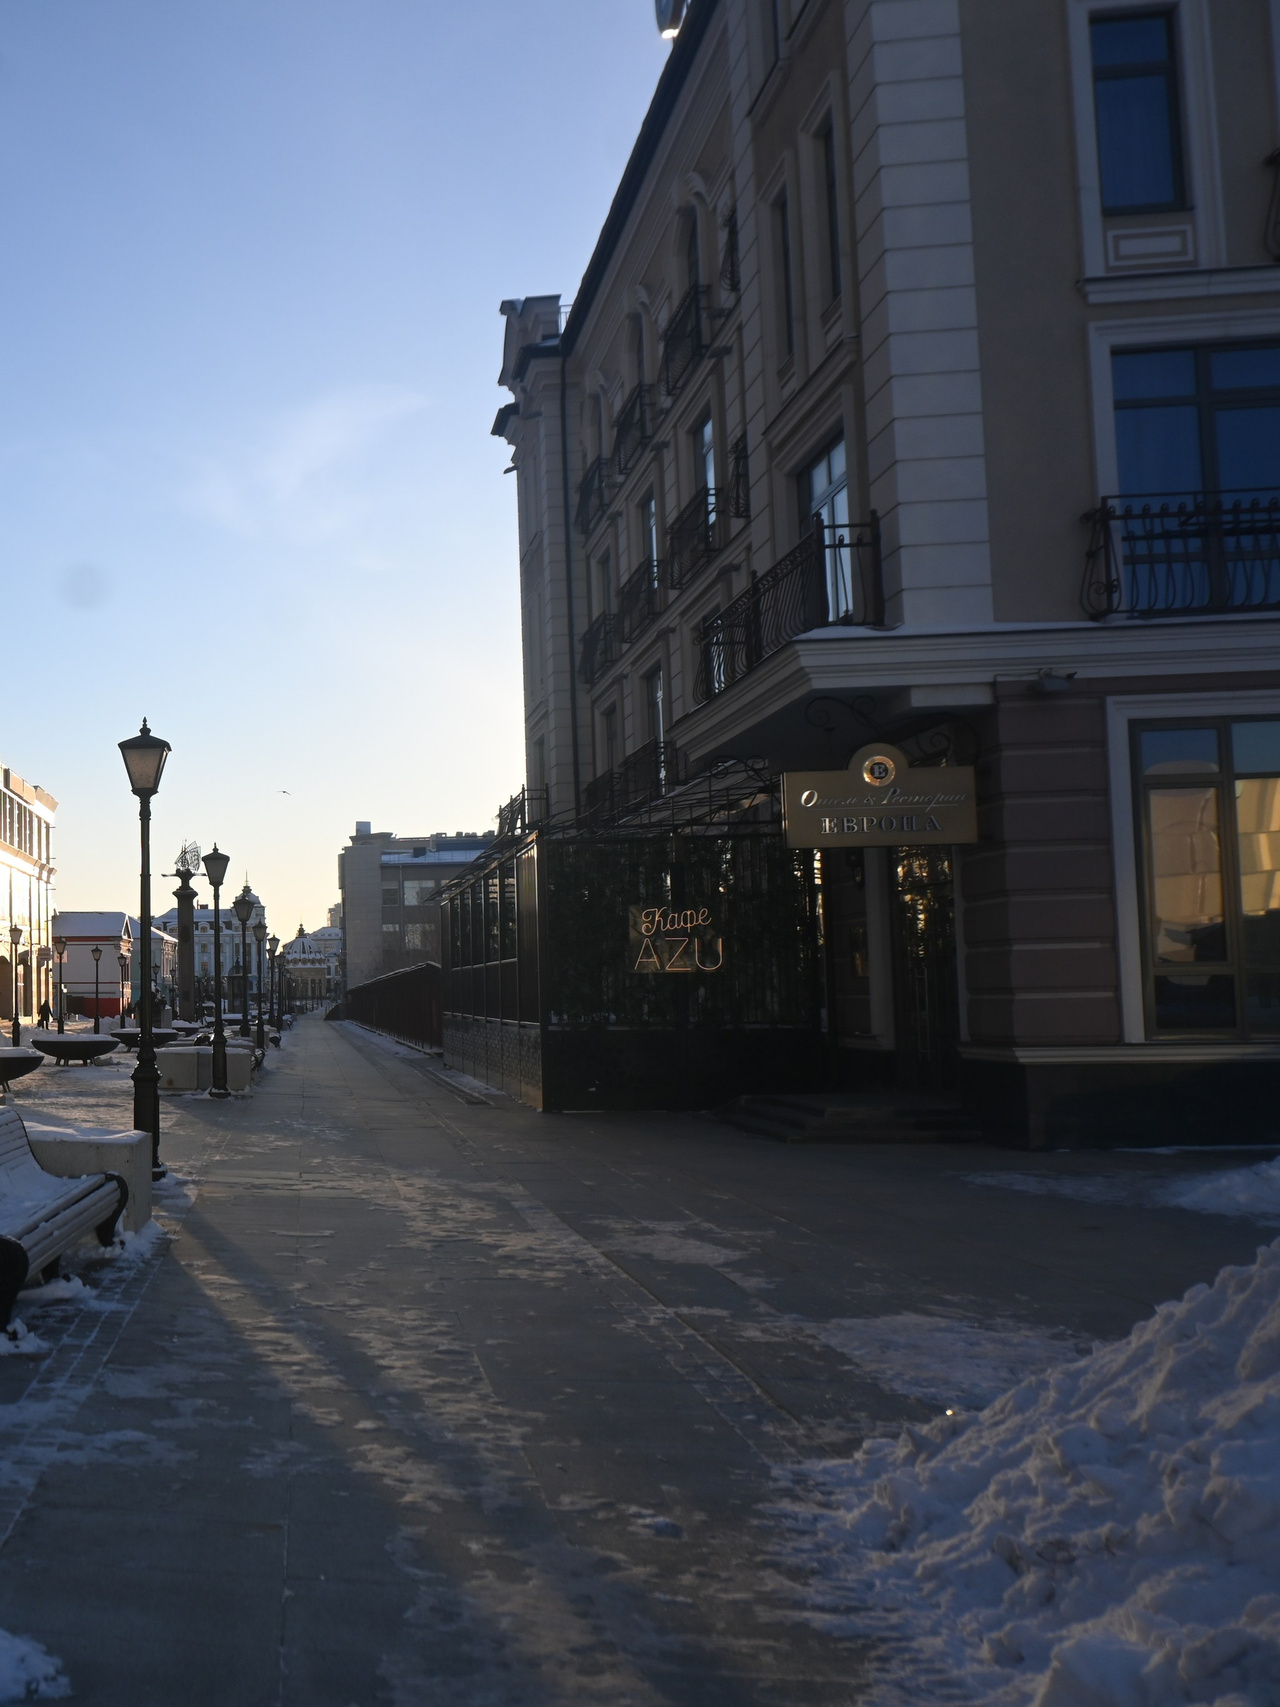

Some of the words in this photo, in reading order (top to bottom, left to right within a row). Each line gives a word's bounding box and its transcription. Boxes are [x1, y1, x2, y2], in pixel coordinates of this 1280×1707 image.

[880, 787, 967, 813] Ресторан
[821, 814, 942, 834] ЕВРОПА
[641, 906, 713, 936] Кафе
[634, 937, 723, 971] AZU
